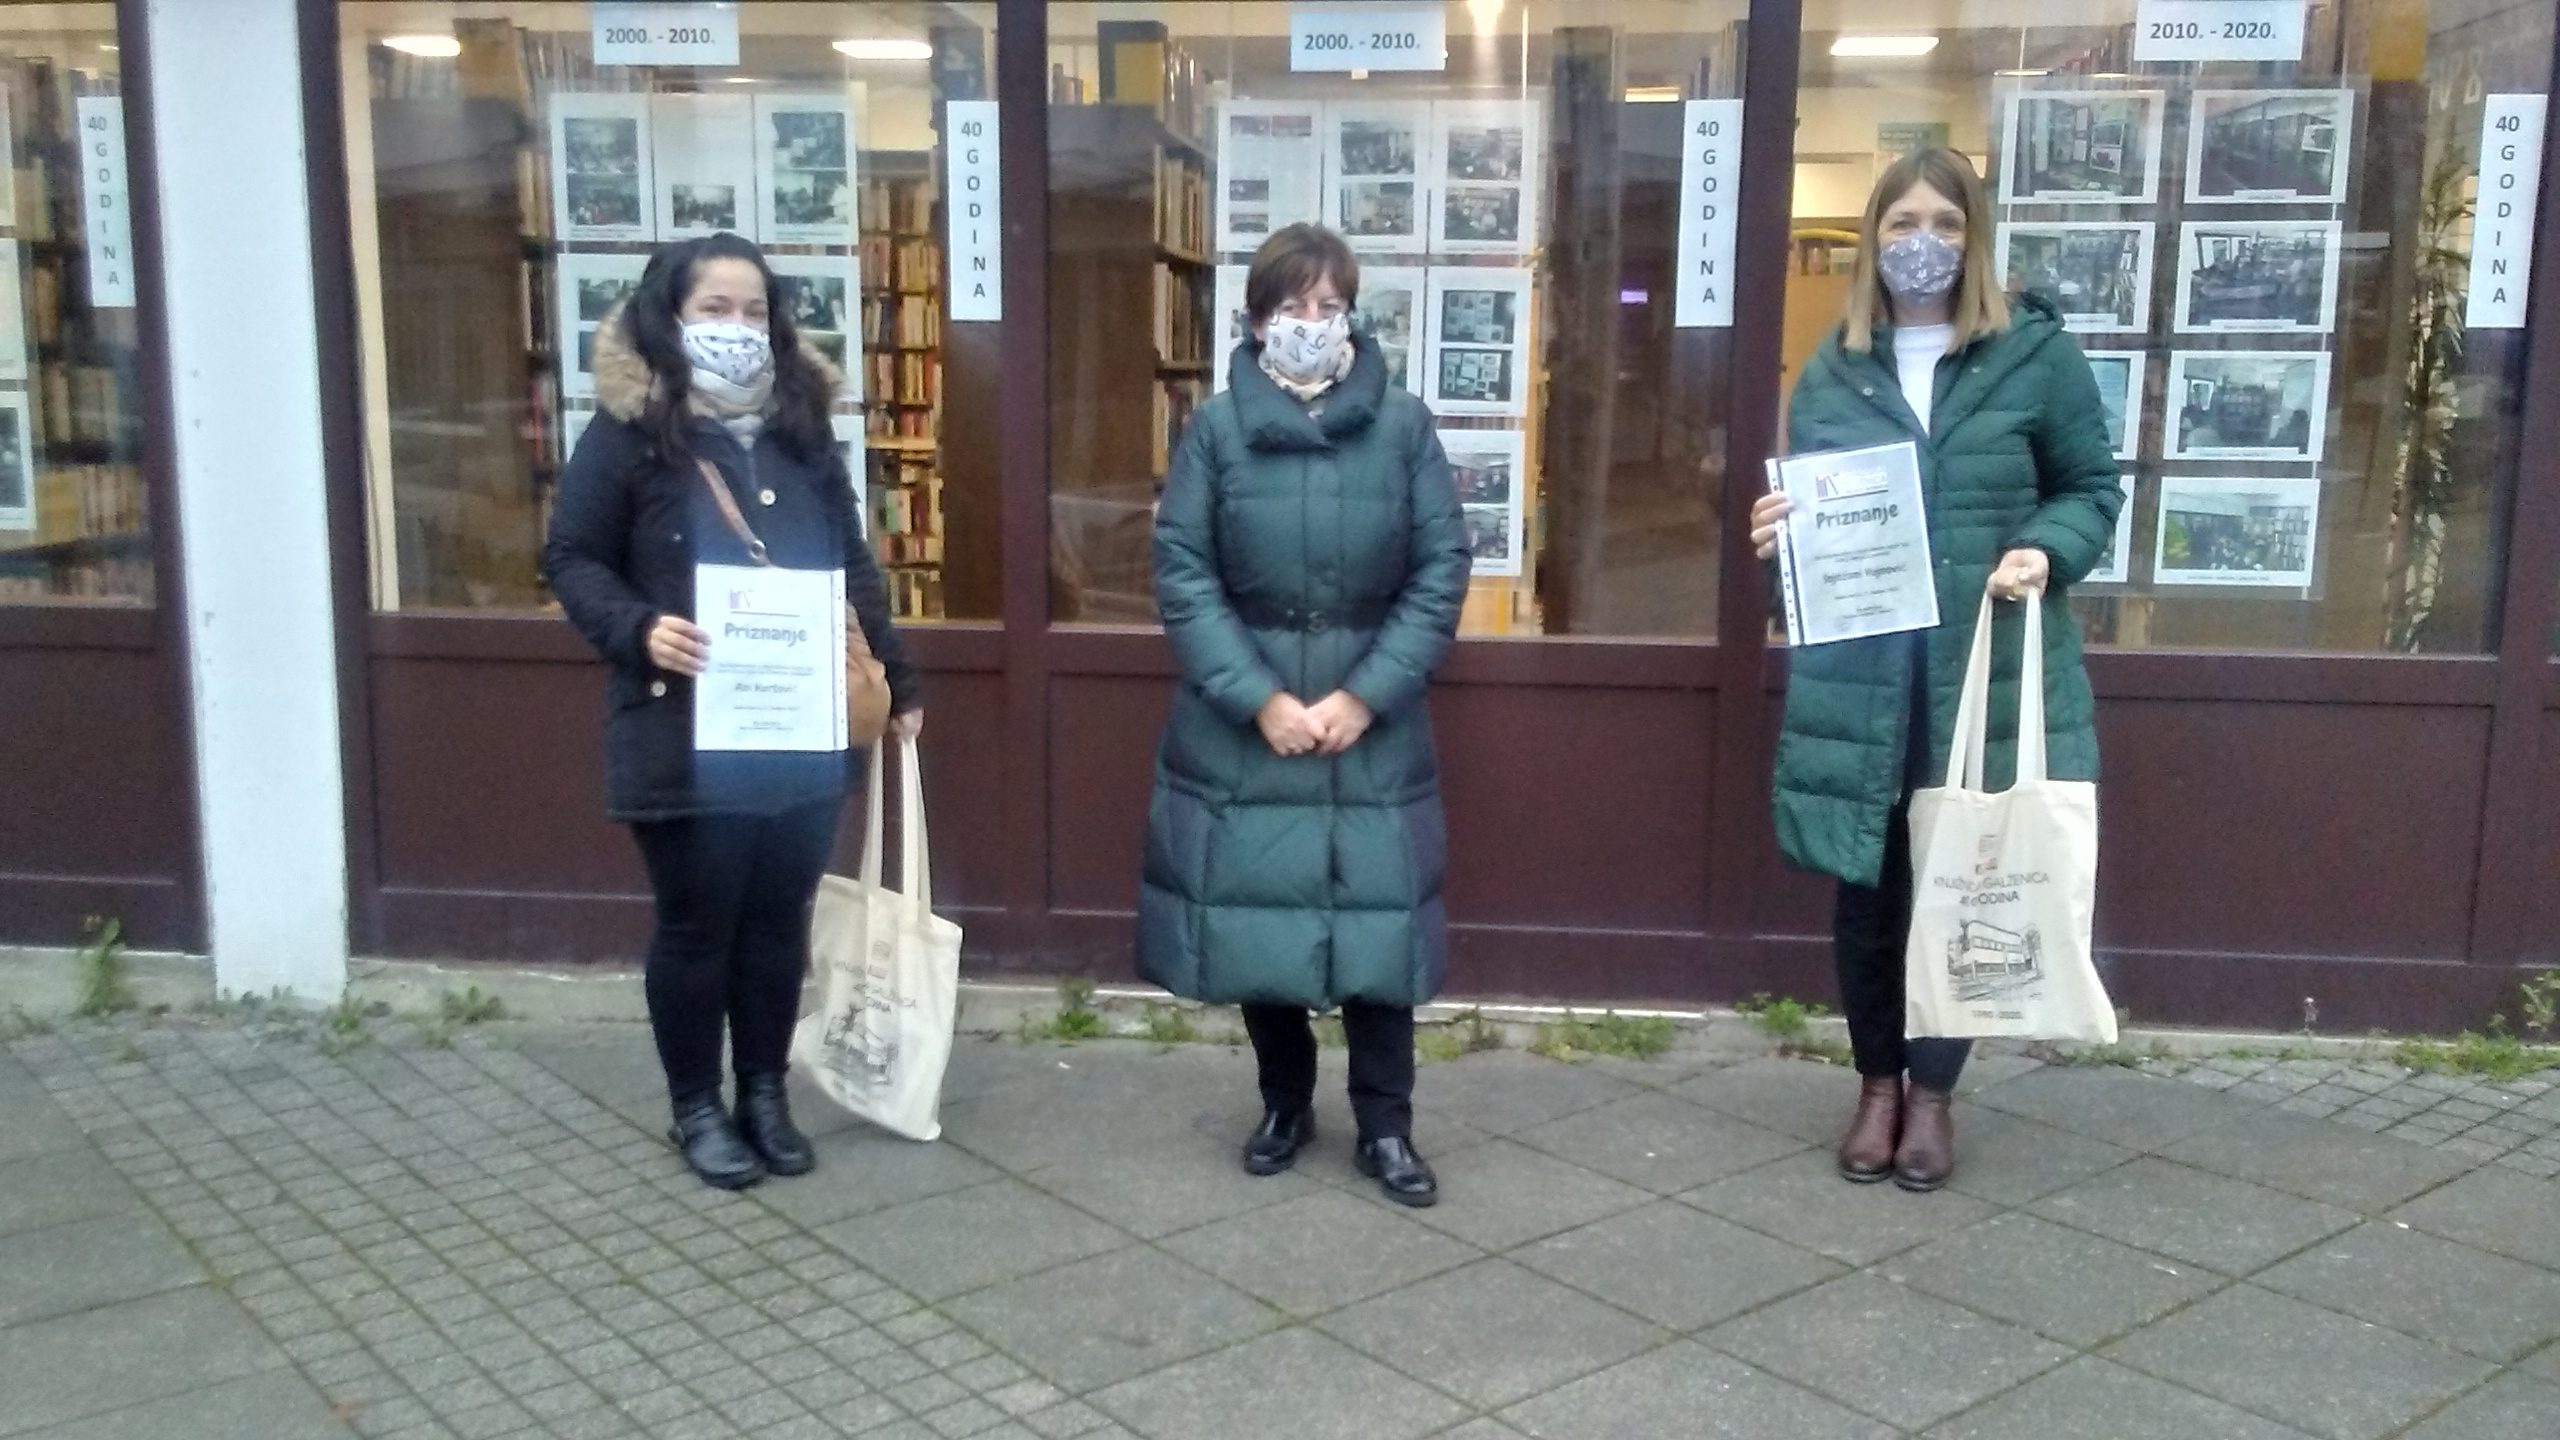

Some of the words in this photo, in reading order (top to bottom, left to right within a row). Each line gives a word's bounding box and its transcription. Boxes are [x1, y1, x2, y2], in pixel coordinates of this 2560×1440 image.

[605, 28, 653, 44] 2000.
[668, 28, 716, 44] 2010.
[2150, 22, 2204, 40] 2010.
[2223, 22, 2277, 40] 2020.
[1304, 34, 1354, 50] 2000.
[1371, 33, 1421, 50] 2010.
[87, 116, 108, 131] 40
[961, 121, 983, 137] 40
[1696, 121, 1720, 137] 40
[2495, 116, 2521, 133] 40
[966, 149, 987, 298] GODINA
[1700, 149, 1718, 304] GODINA
[2492, 145, 2516, 304] GODINA
[1815, 503, 1900, 530] Priznanje
[724, 622, 808, 648] Priznanje
